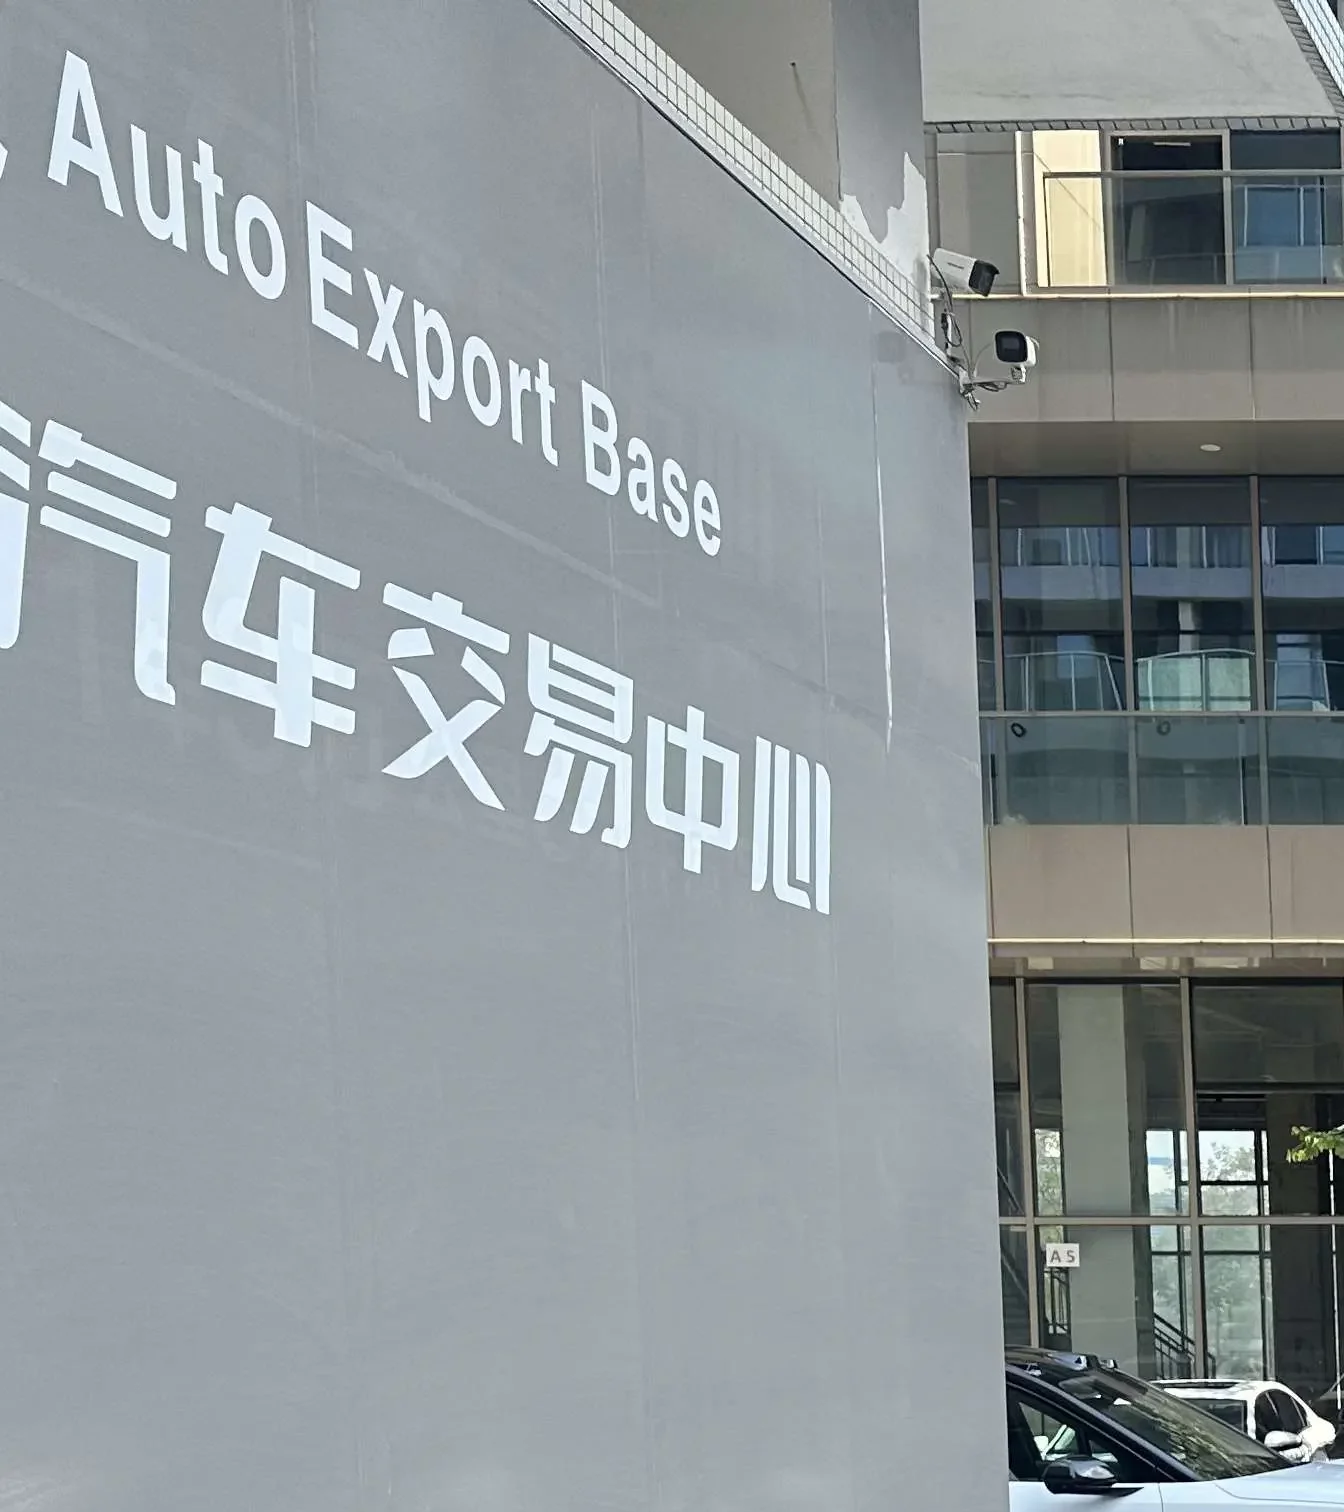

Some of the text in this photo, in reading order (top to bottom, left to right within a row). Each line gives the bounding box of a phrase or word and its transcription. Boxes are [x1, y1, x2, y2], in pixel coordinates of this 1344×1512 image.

[47, 50, 721, 557] Auto Export Base
[0, 400, 831, 915] 汽车交易中心
